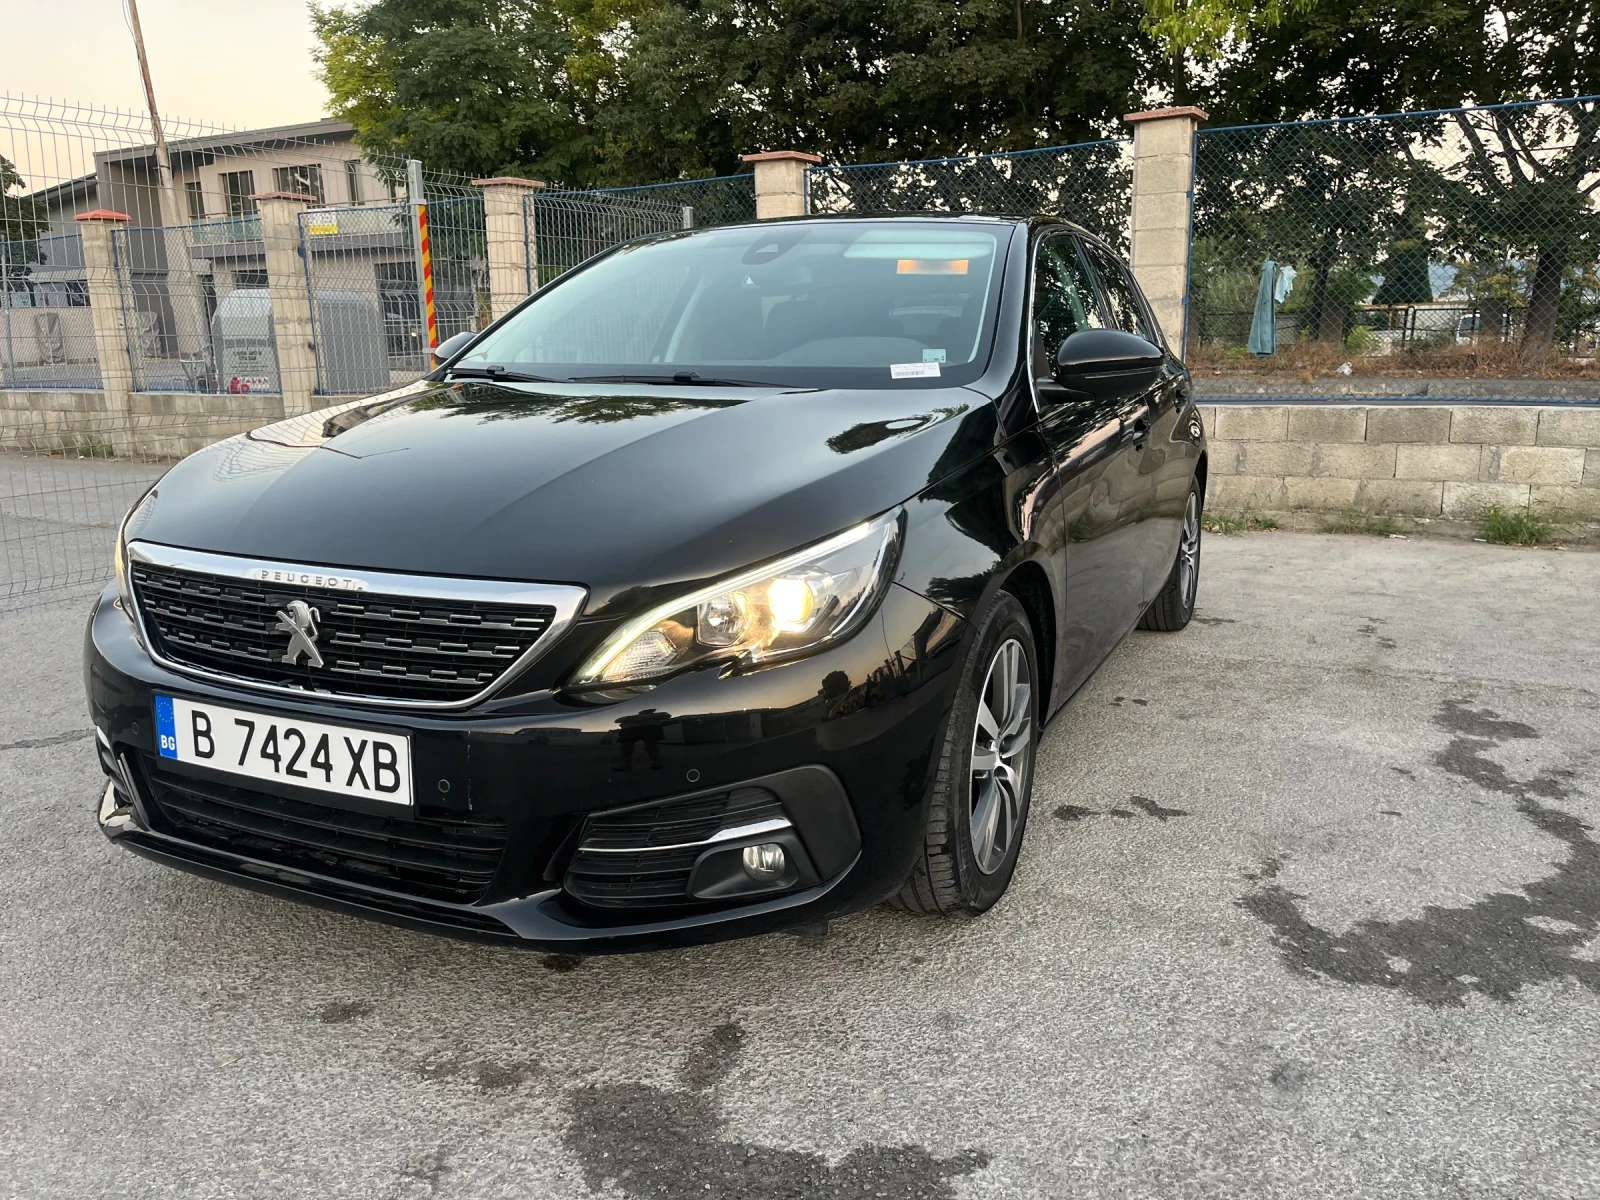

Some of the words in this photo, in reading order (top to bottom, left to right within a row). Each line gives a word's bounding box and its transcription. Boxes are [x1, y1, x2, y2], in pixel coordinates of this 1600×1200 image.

[261, 570, 352, 588] PEUGEOT
[161, 734, 176, 750] BG
[191, 709, 215, 759] B
[234, 717, 333, 783] 7424
